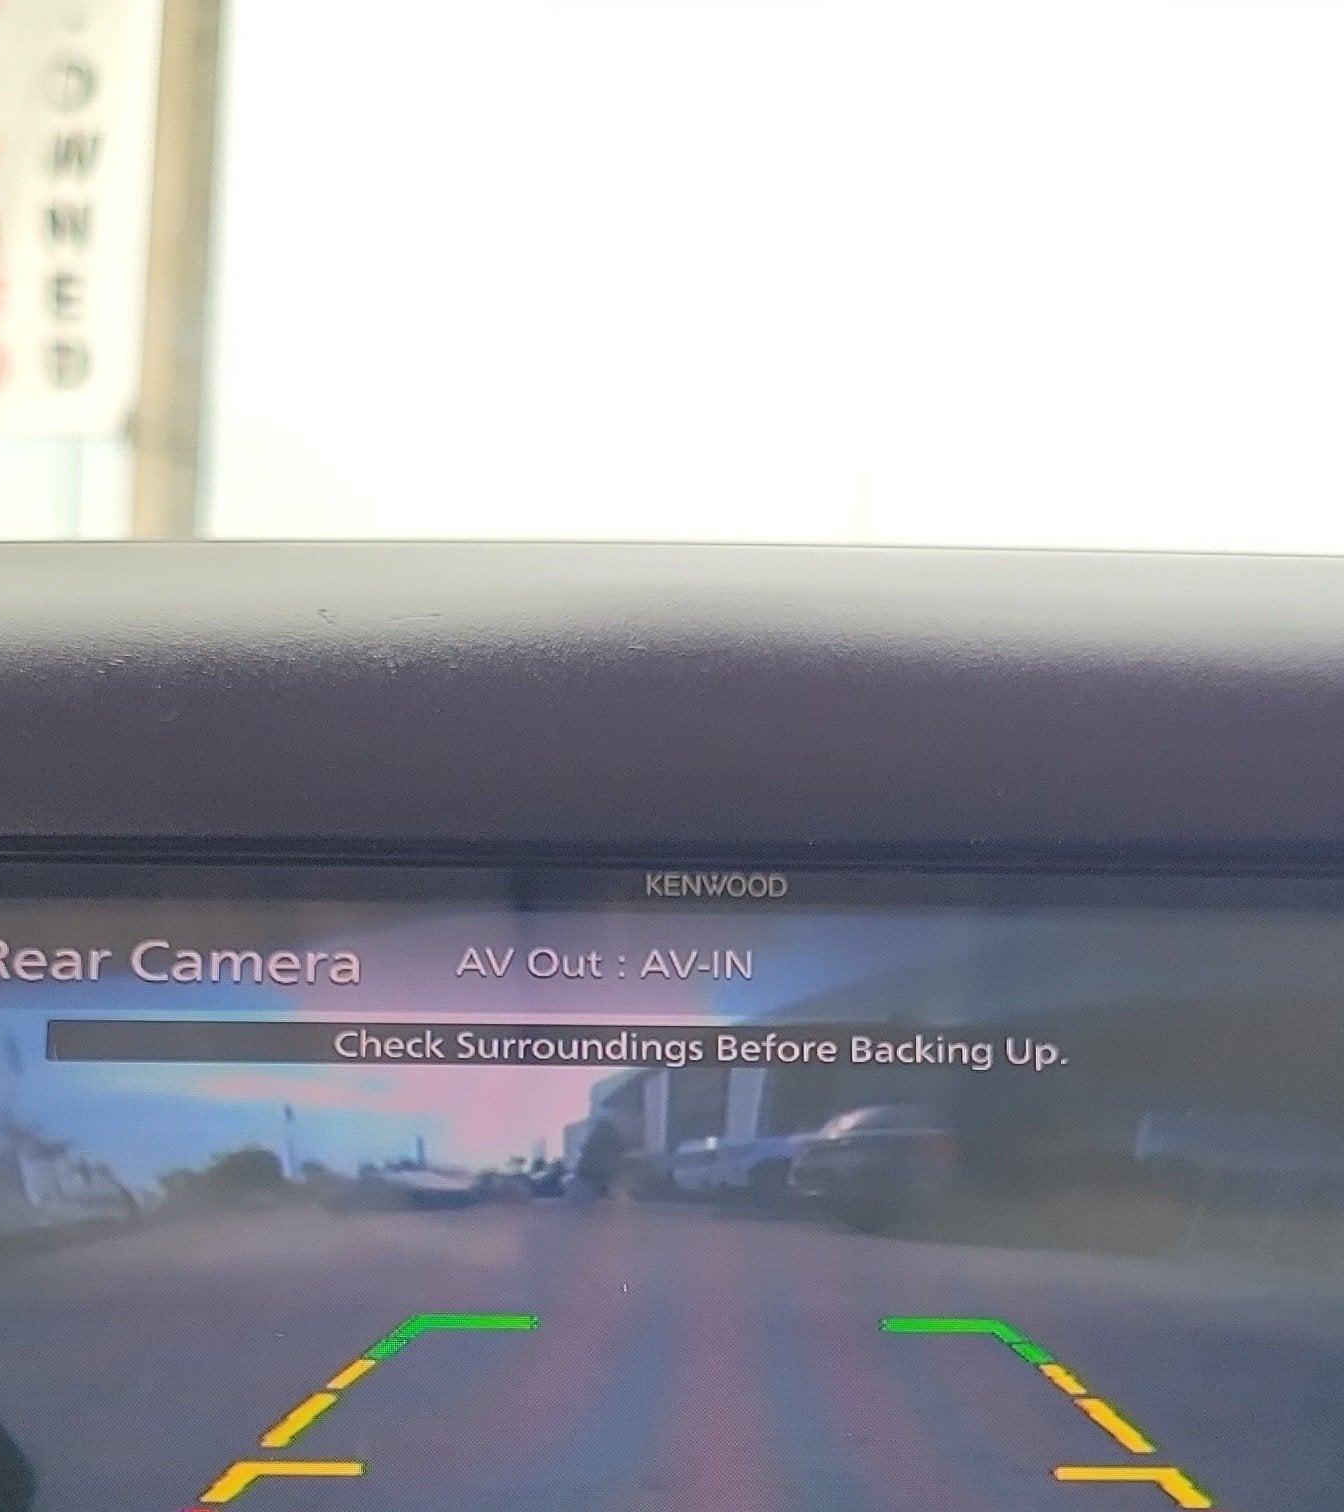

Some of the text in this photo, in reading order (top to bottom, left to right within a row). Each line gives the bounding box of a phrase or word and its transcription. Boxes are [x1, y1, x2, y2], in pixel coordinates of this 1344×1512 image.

[646, 871, 789, 898] KENWOOD
[131, 938, 362, 985] Camera
[456, 946, 515, 978] AV
[526, 947, 602, 979] Out
[639, 949, 754, 981] AV-IN
[333, 1030, 1069, 1072] Check Surroundings Before Backing Up.
